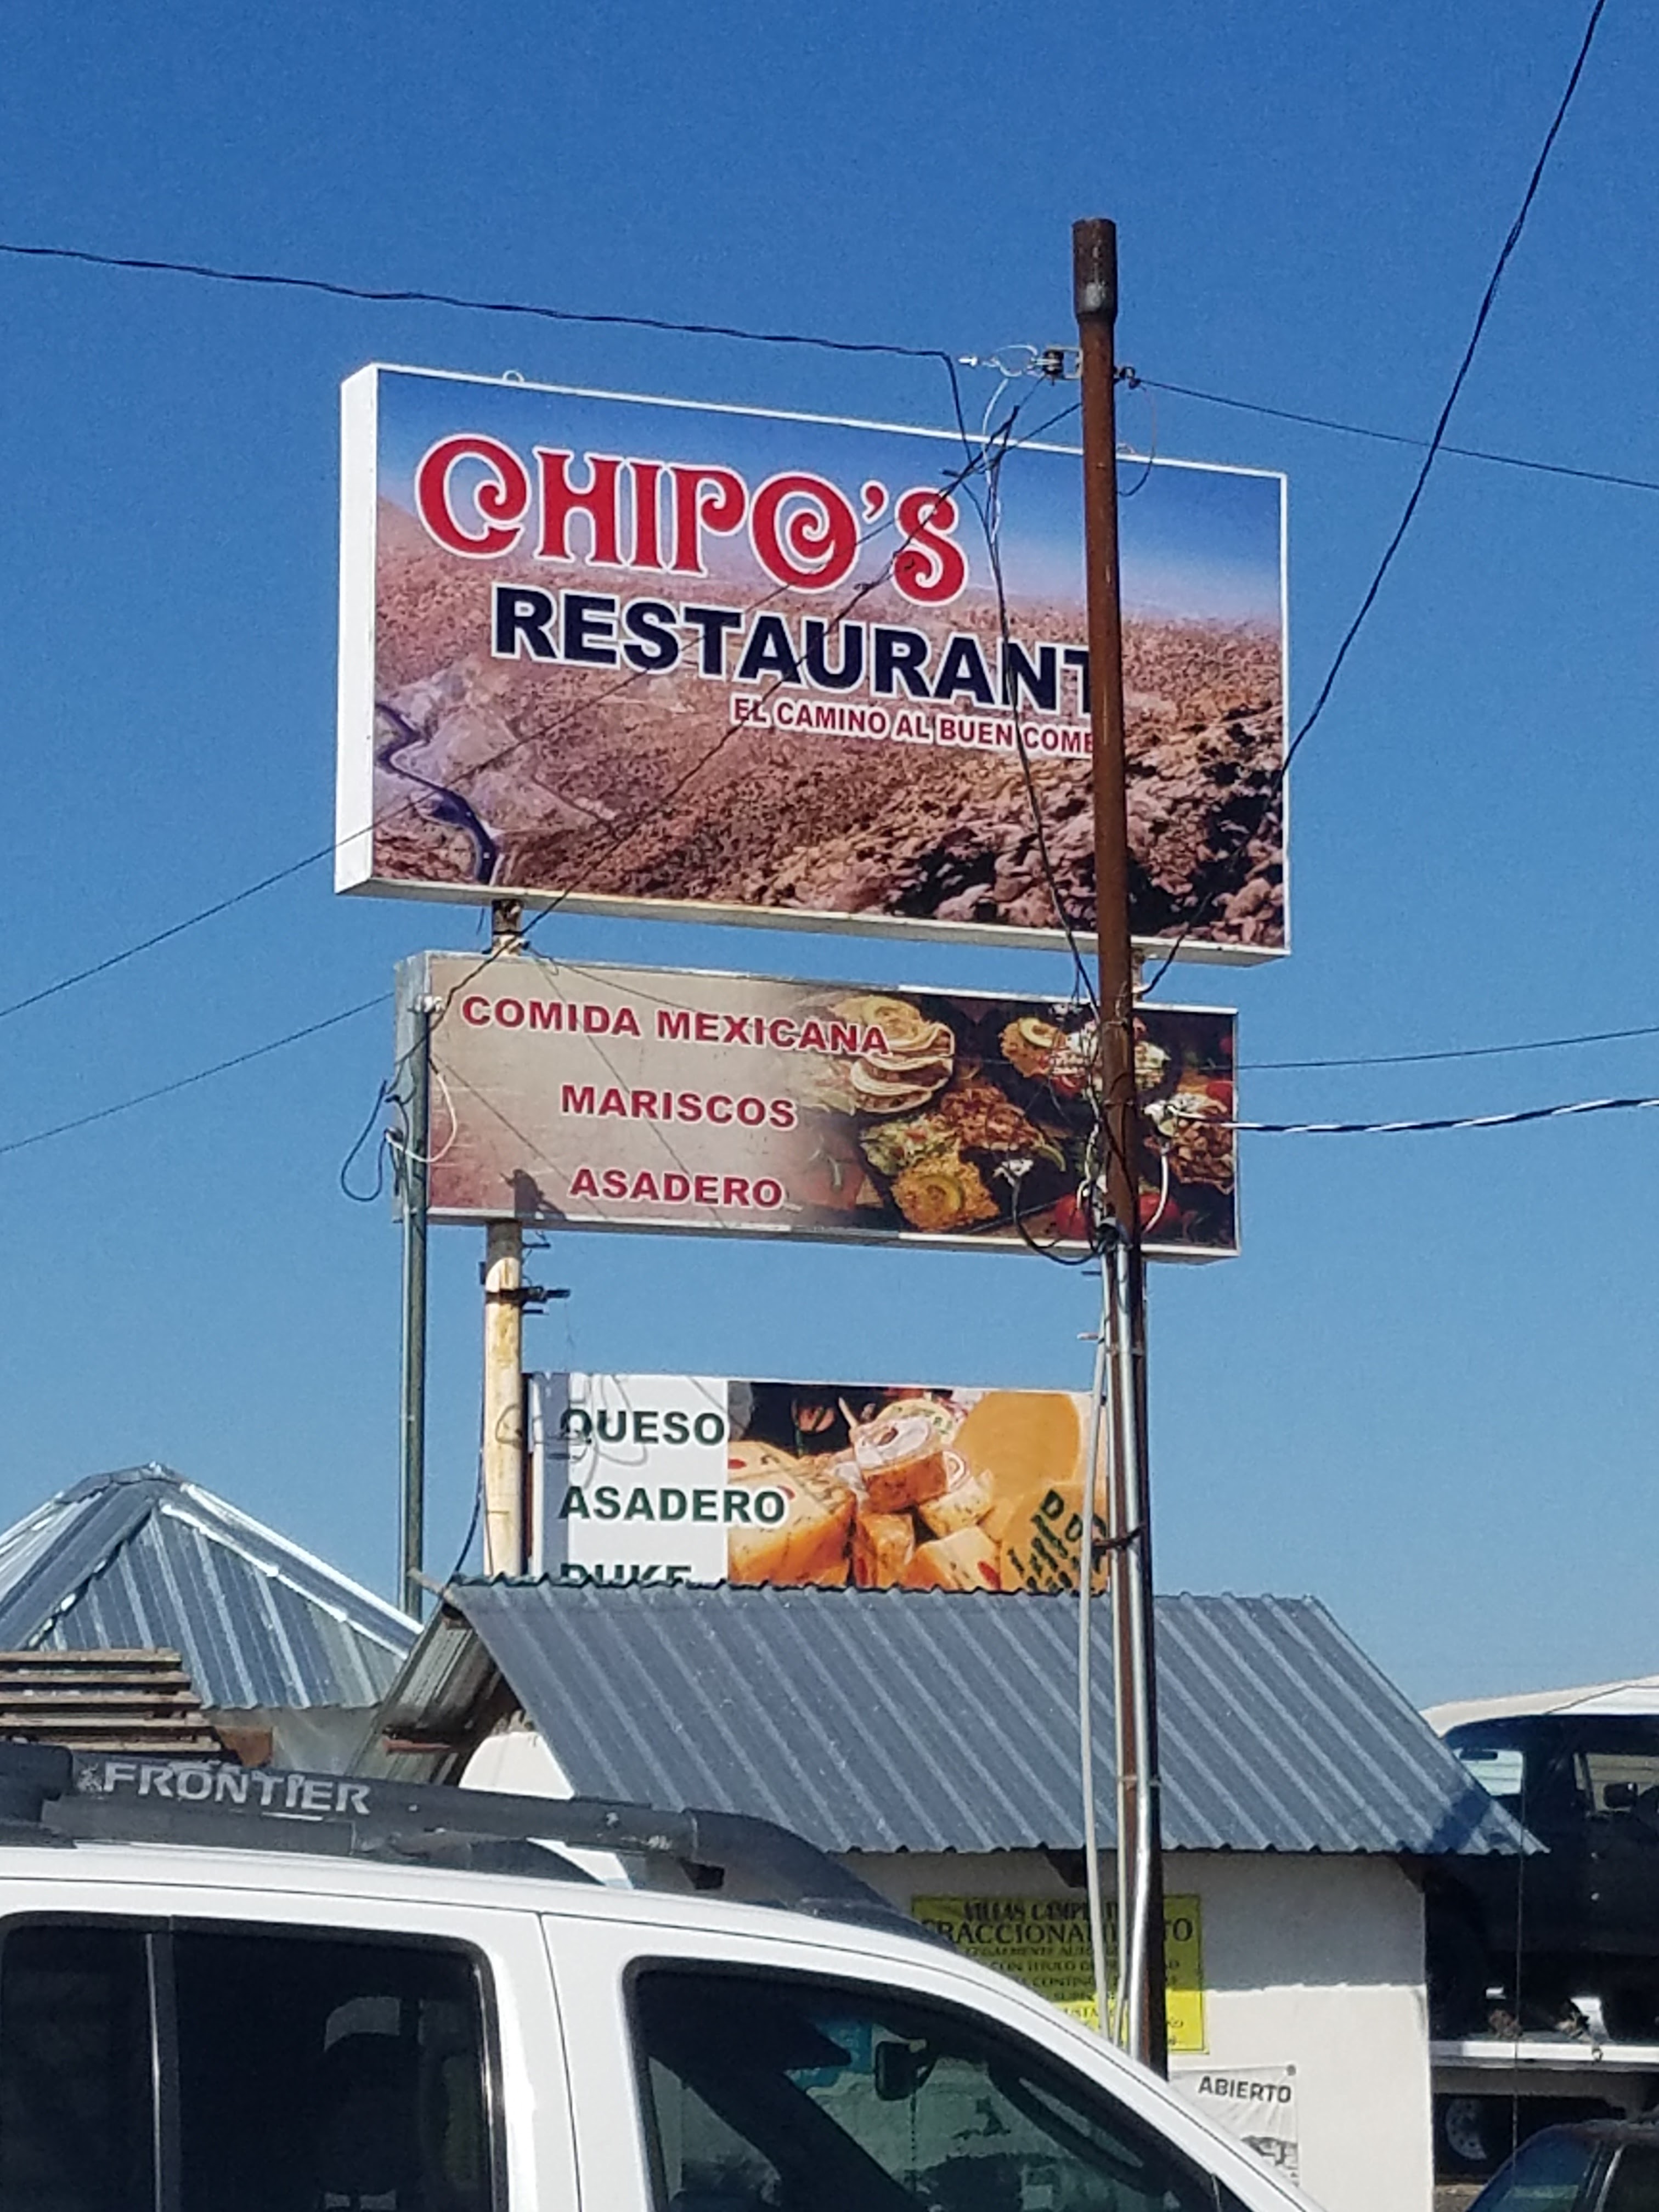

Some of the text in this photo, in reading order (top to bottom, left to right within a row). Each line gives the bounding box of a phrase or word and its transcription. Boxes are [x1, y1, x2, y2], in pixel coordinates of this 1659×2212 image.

[734, 699, 1093, 754] EL CAMINO AL BUEN COME
[462, 996, 890, 1056] COMIDA MEXICANA
[562, 1084, 795, 1128] MARISCOS
[570, 1167, 782, 1208] ASADERO
[560, 1408, 725, 1446] QUESO
[558, 1485, 785, 1524] ASADERO
[103, 1762, 370, 1814] FRONTIER
[1199, 2075, 1291, 2103] ABIERTO
